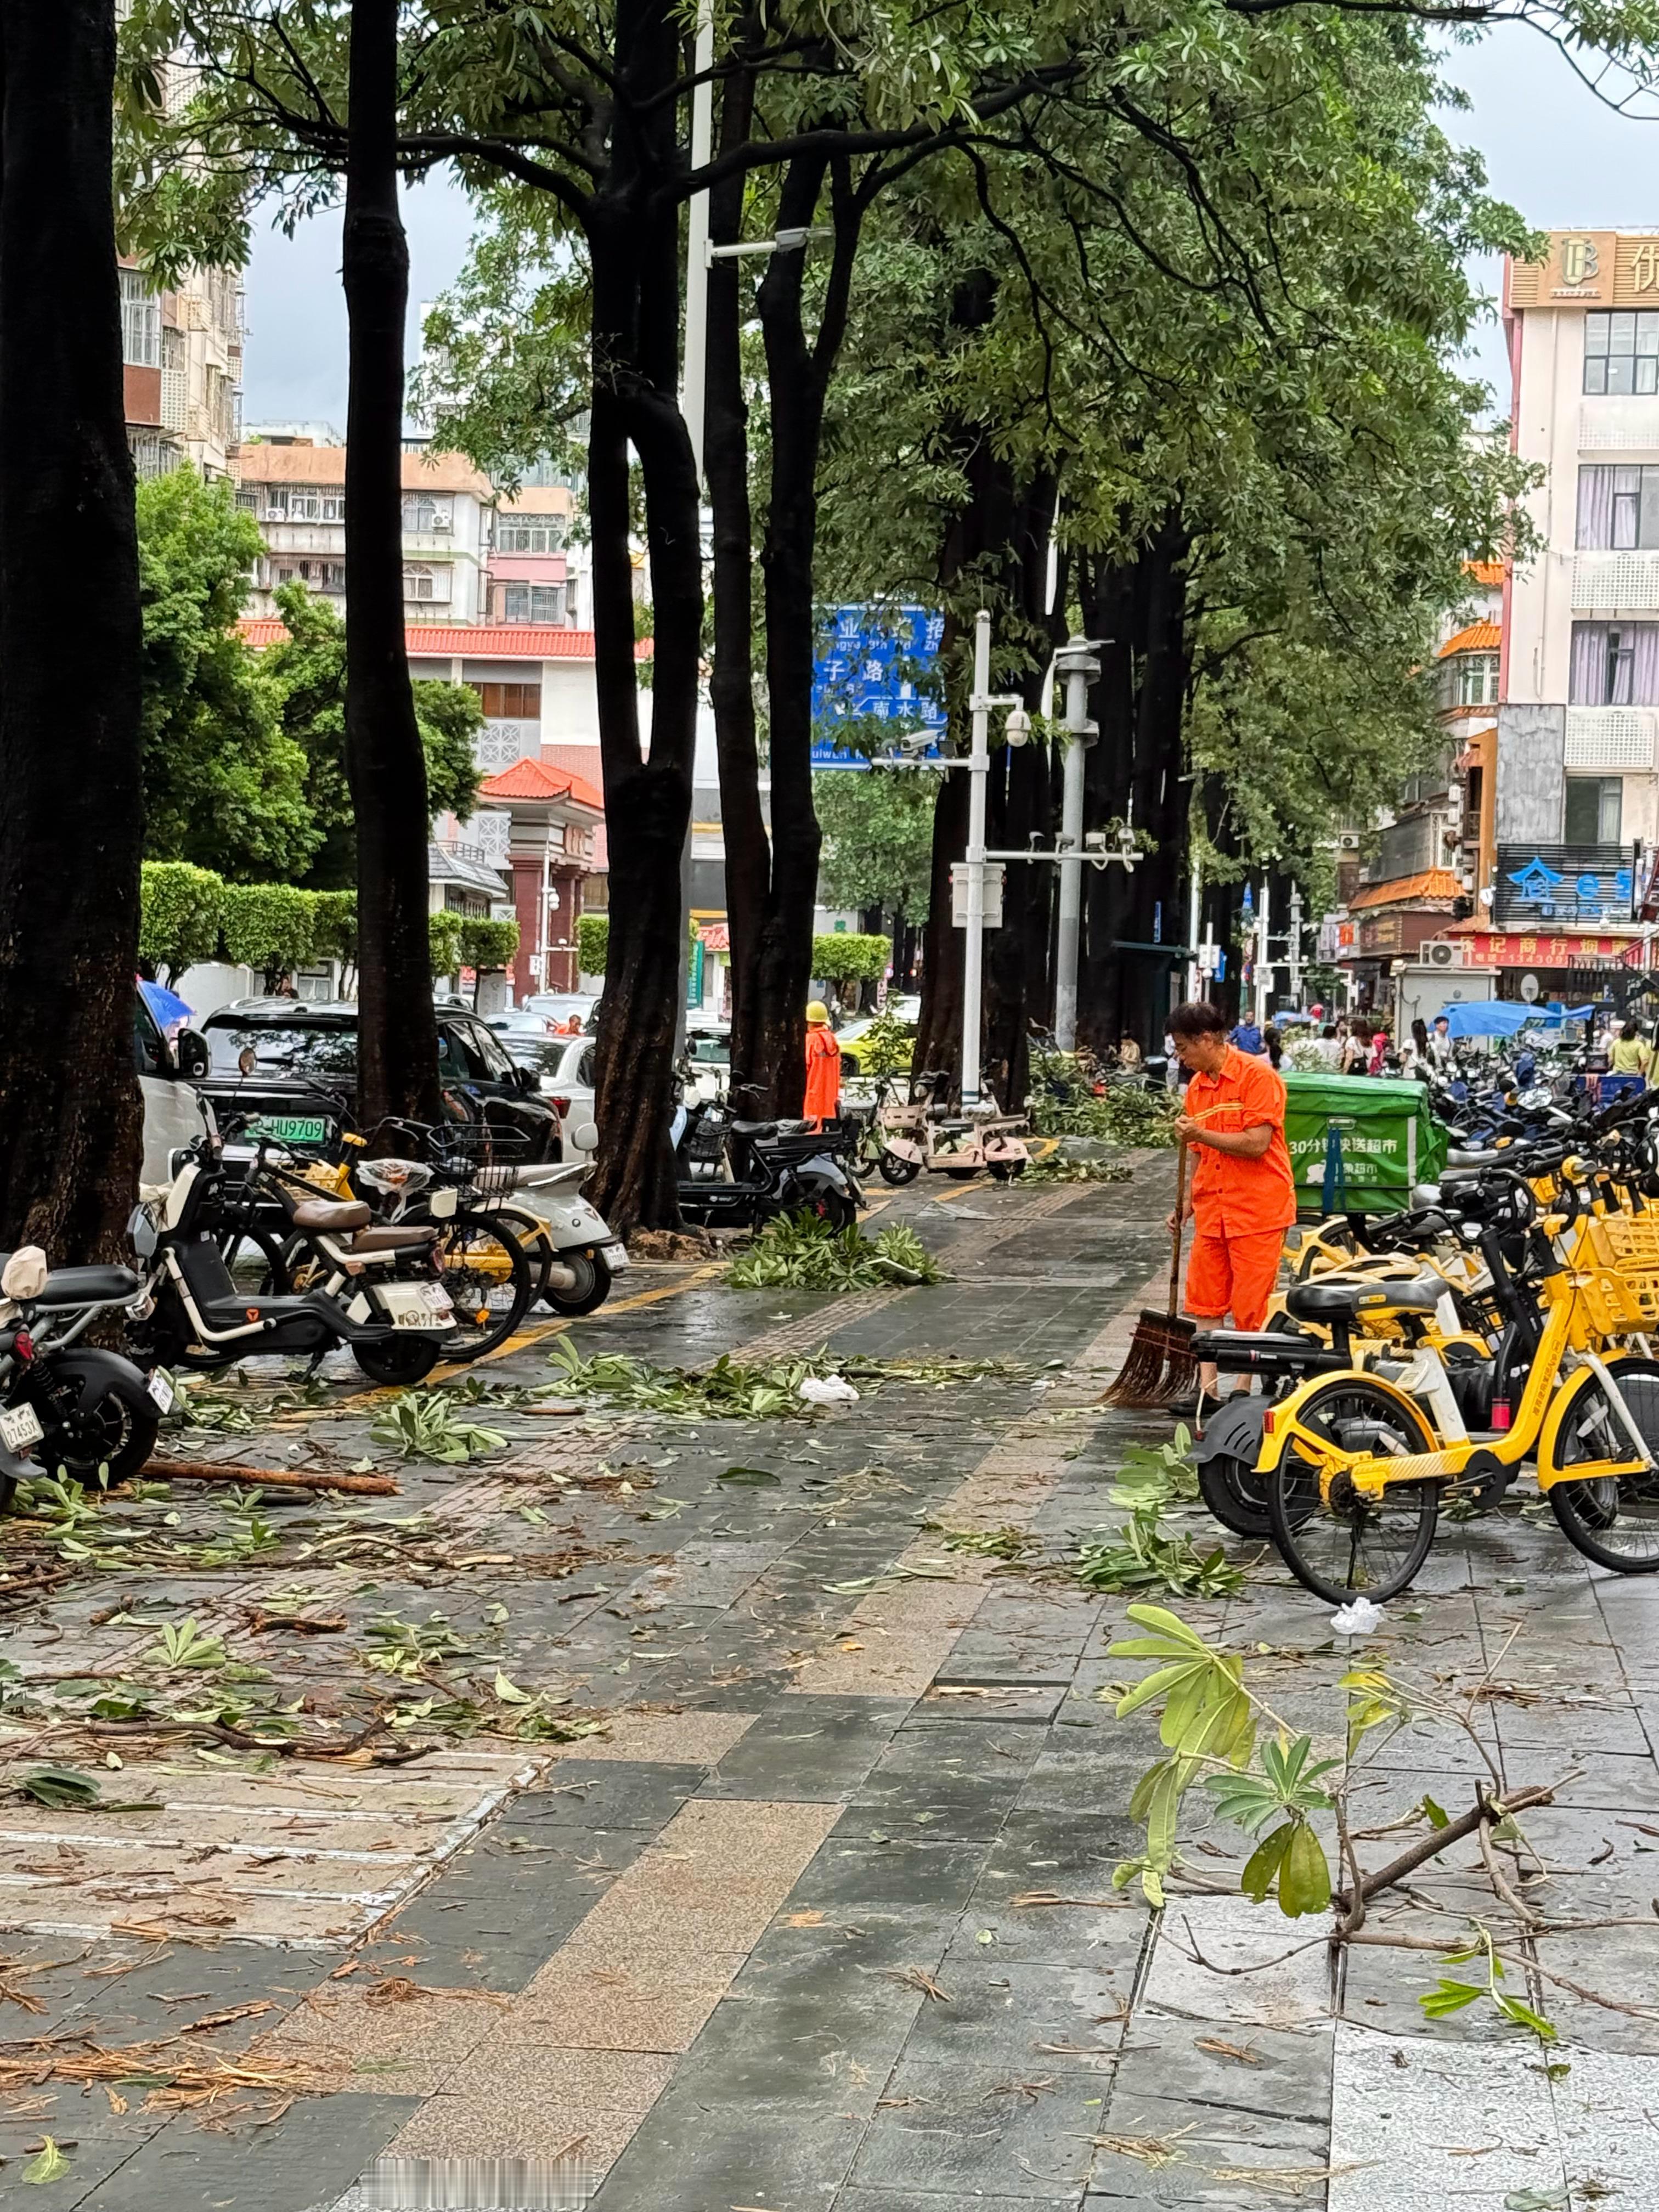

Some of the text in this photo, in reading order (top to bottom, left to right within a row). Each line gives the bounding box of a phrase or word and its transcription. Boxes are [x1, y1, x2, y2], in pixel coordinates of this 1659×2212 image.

[249, 1117, 322, 1138] HU9709
[1333, 1162, 1378, 1175] 象超市
